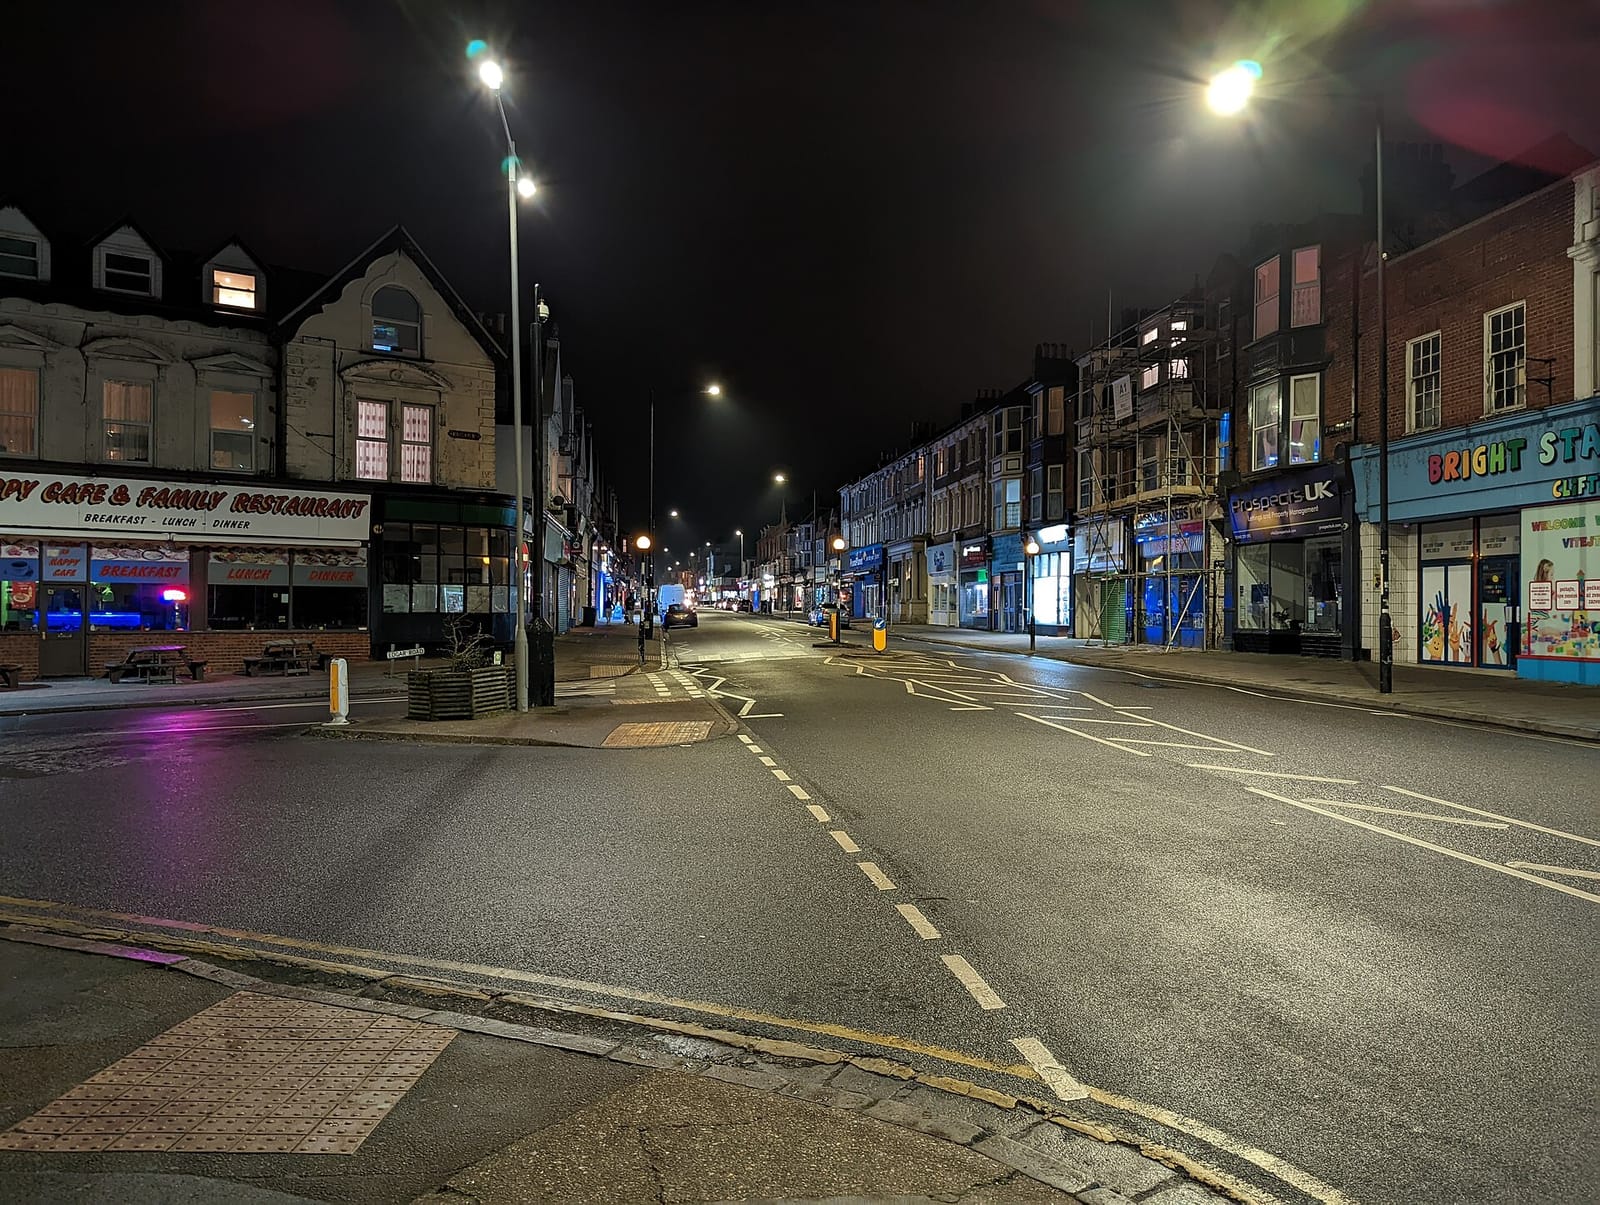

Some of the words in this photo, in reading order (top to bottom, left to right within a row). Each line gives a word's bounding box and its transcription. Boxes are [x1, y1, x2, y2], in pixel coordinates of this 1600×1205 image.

[1428, 437, 1527, 485] BRIGHT
[1538, 422, 1600, 465] STA
[1304, 480, 1334, 501] UK
[1552, 475, 1600, 498] CLIFT
[41, 481, 109, 506] CAFE
[108, 484, 131, 506] &
[136, 486, 228, 511] FAMILY
[230, 492, 368, 519] RESTAURANT
[84, 513, 147, 525] BREAKFAST
[162, 517, 197, 527] LUNCH
[213, 519, 250, 529] DINNER
[1531, 517, 1585, 531] WELCOME
[49, 558, 80, 566] HAPPY
[100, 565, 181, 578] BREAKFAST
[227, 568, 272, 580] LUNCH
[309, 570, 354, 581] DINNER
